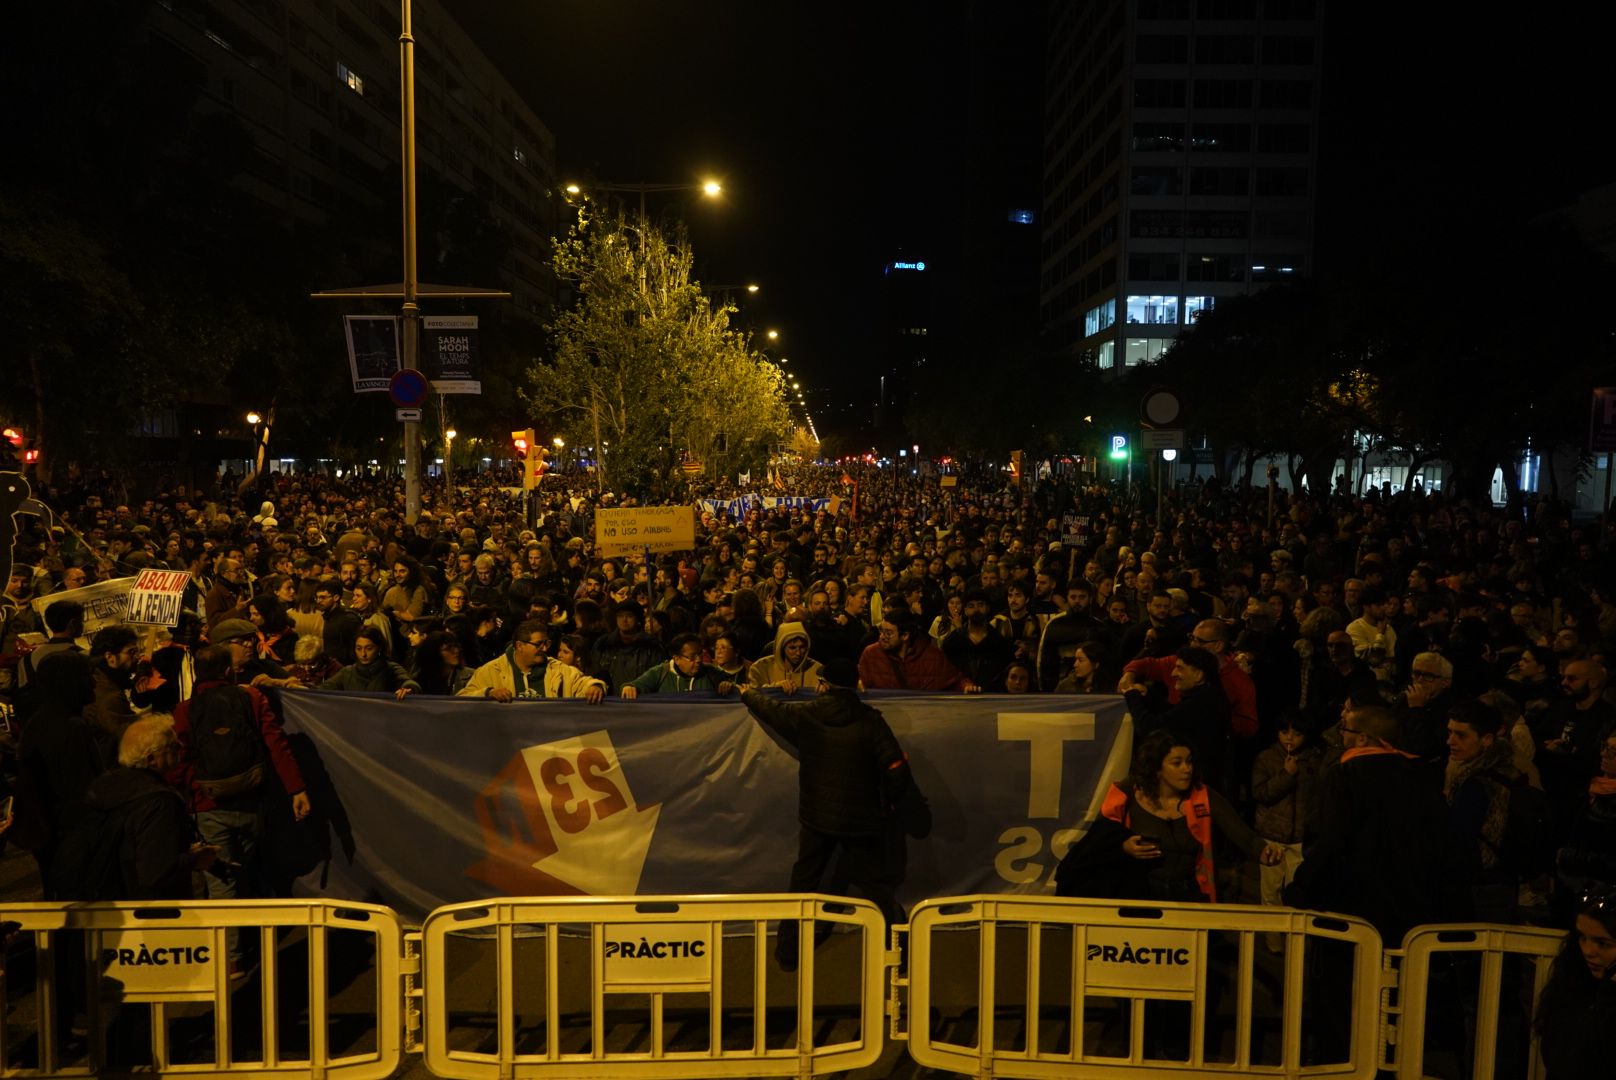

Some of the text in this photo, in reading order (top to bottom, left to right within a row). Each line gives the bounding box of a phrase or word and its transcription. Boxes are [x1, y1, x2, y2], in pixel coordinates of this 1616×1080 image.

[438, 336, 469, 344] SARAH
[439, 344, 469, 352] MOON
[1113, 436, 1126, 452] P
[604, 527, 617, 537] NO
[622, 527, 638, 536] USO
[137, 571, 187, 592] ABOLIM
[130, 593, 176, 623] LA RENDA
[102, 943, 210, 966] PRÀCTIC
[606, 937, 705, 958] PRÀCTIC
[1087, 941, 1190, 966] PRÀCTIC
